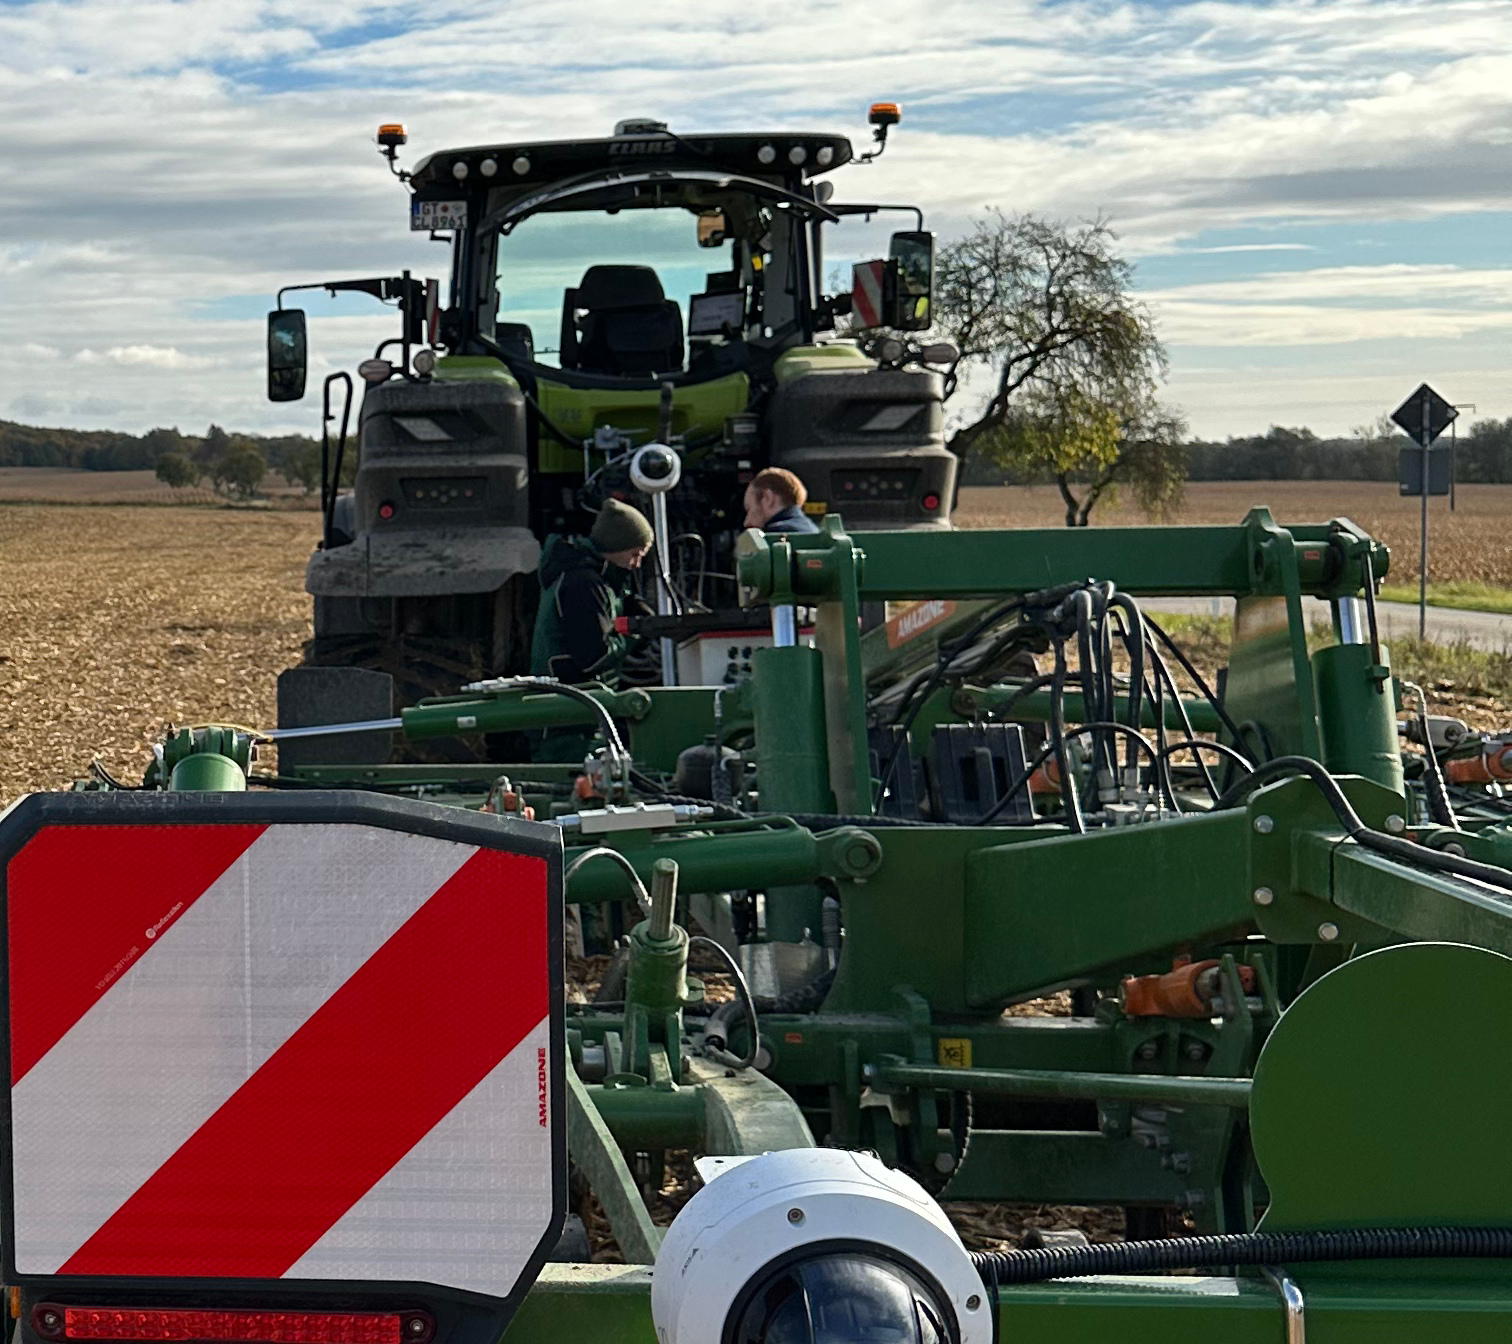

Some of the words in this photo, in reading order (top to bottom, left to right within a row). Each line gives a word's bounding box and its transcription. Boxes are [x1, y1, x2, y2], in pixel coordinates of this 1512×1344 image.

[609, 140, 676, 155] CLAAS
[897, 600, 945, 638] AMAZONE
[537, 1047, 546, 1128] AMAZONE
